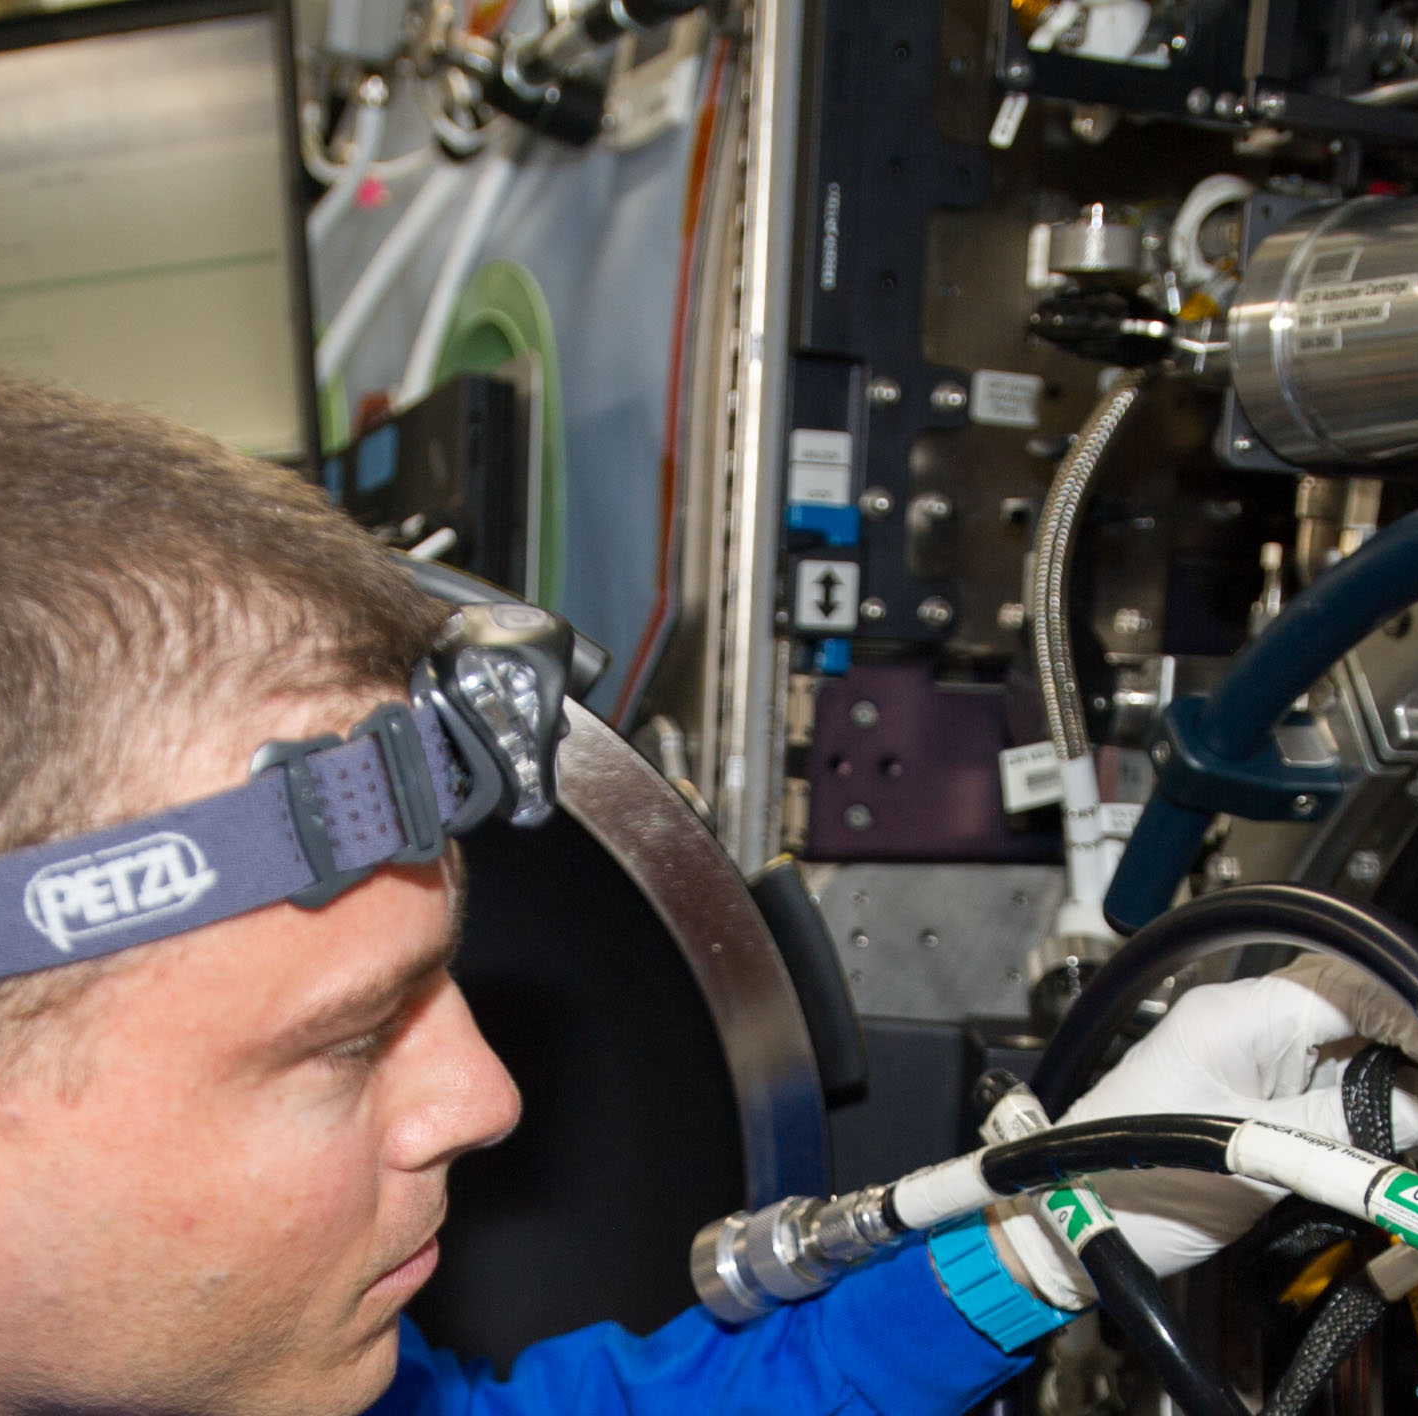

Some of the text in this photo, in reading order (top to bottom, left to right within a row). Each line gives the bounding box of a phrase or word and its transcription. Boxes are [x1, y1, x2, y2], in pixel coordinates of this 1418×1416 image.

[35, 841, 219, 952] PETZL
[1252, 1119, 1377, 1166] MDCA Supply Hose
